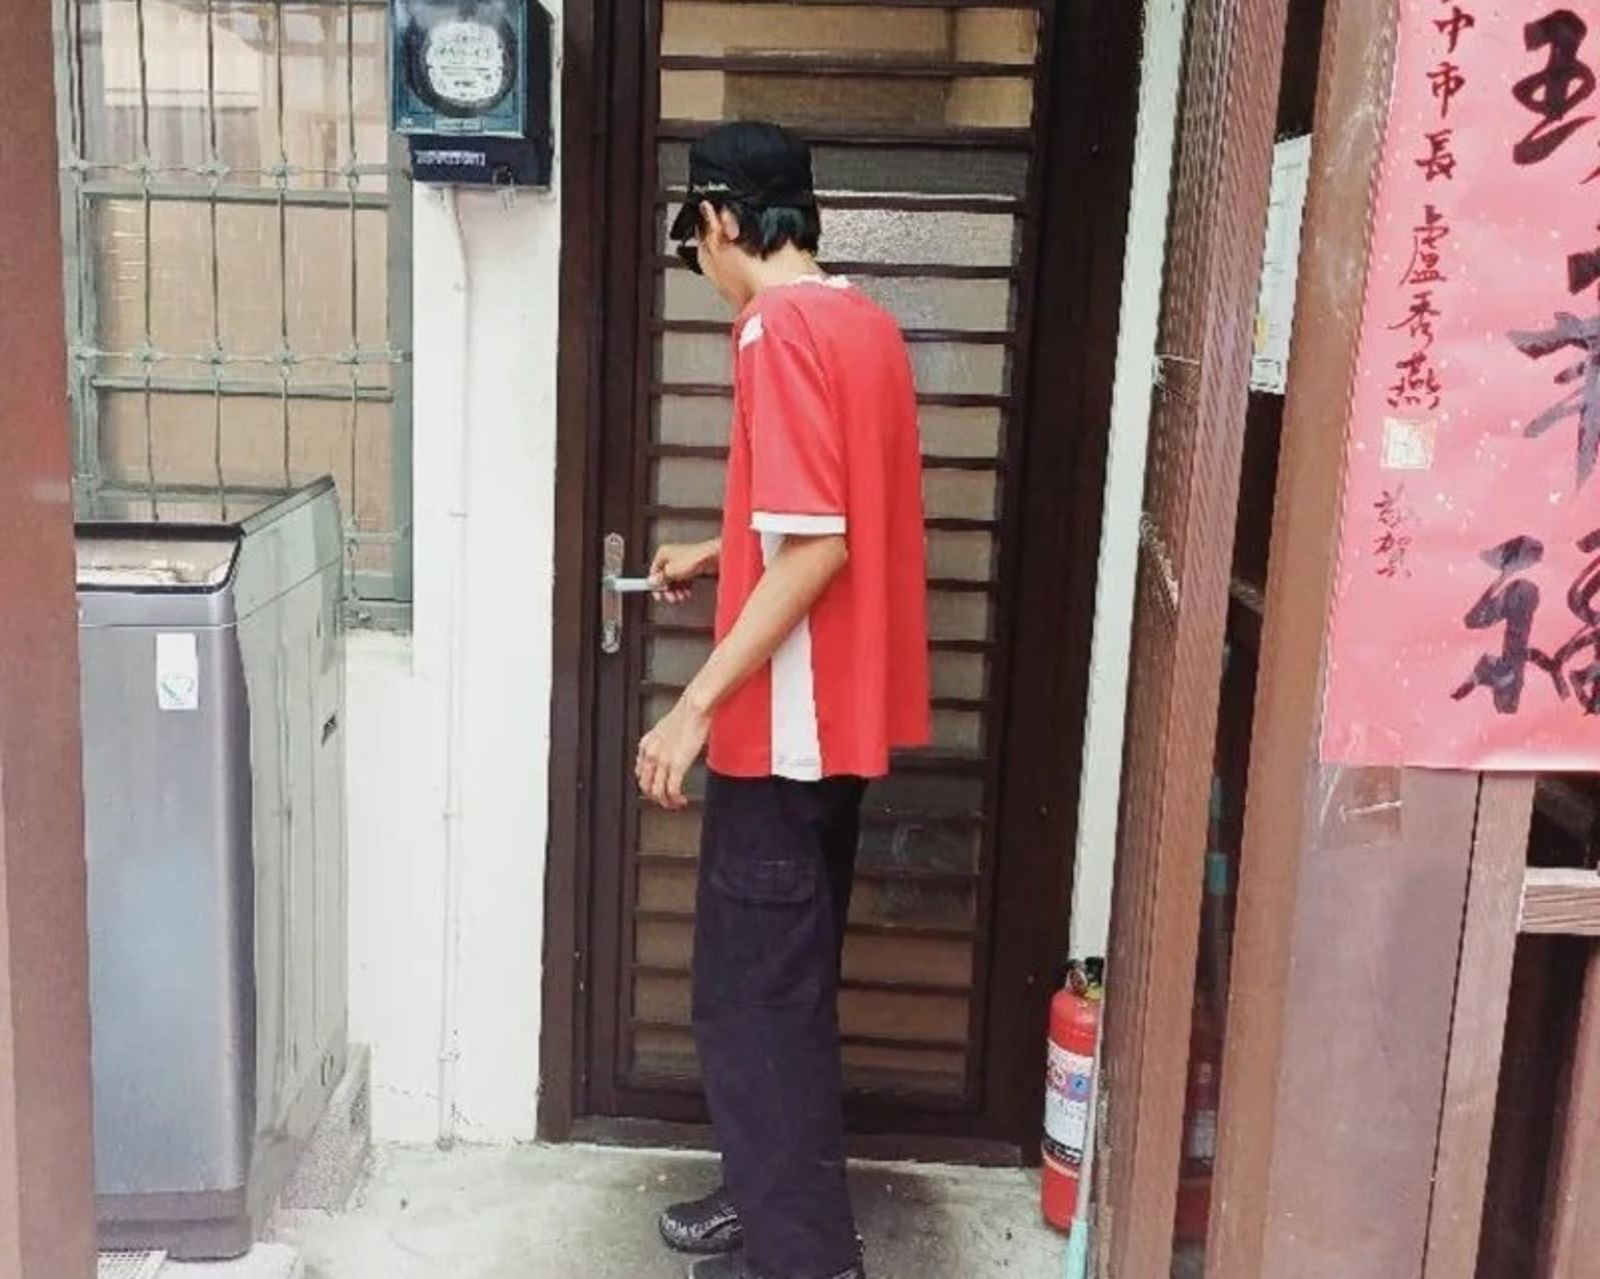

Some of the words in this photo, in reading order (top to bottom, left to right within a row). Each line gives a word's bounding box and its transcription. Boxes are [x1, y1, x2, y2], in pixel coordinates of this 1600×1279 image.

[1387, 0, 1475, 410] 中市長盧秀燕
